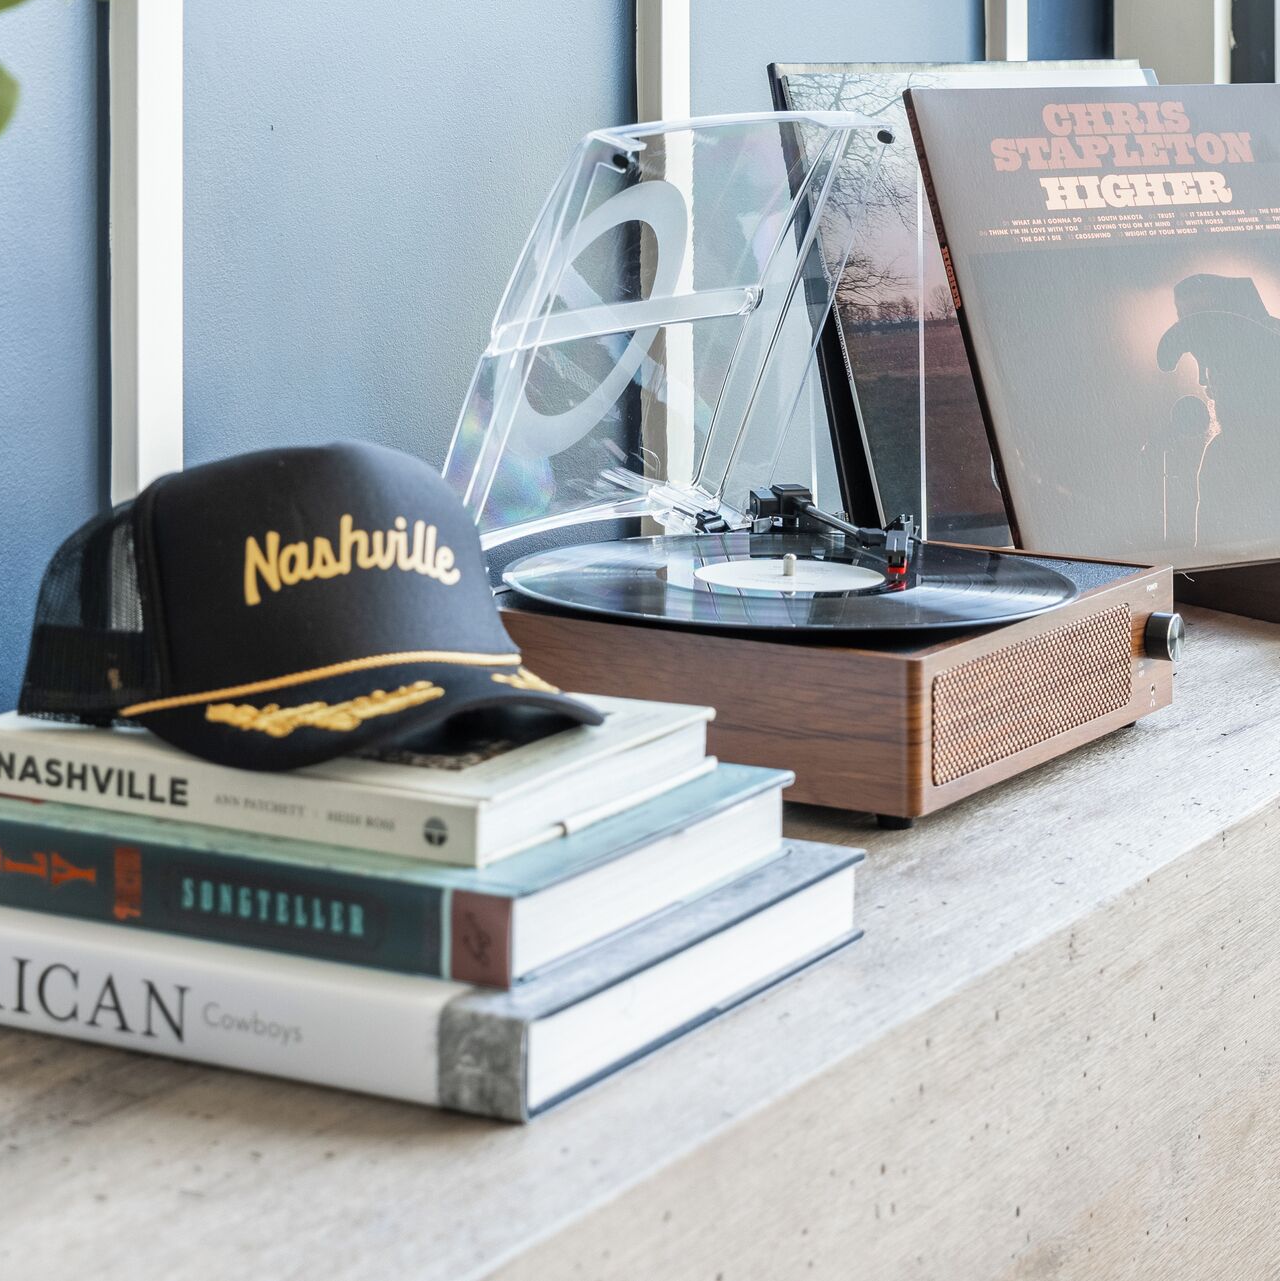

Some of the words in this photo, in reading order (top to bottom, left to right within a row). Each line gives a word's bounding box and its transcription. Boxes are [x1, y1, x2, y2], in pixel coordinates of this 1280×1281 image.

[1042, 101, 1191, 136] CHRIS
[990, 131, 1255, 171] STAPLETON
[1039, 171, 1233, 210] HIGHER
[1075, 232, 1111, 240] CROSSWIND
[1210, 225, 1245, 233] MOUNTAINS
[1197, 210, 1214, 218] TAKES
[941, 245, 962, 310] HIGHER
[243, 514, 461, 606] Nashville
[181, 877, 365, 937] SONGTELLER
[201, 1001, 304, 1045] Cowboys
